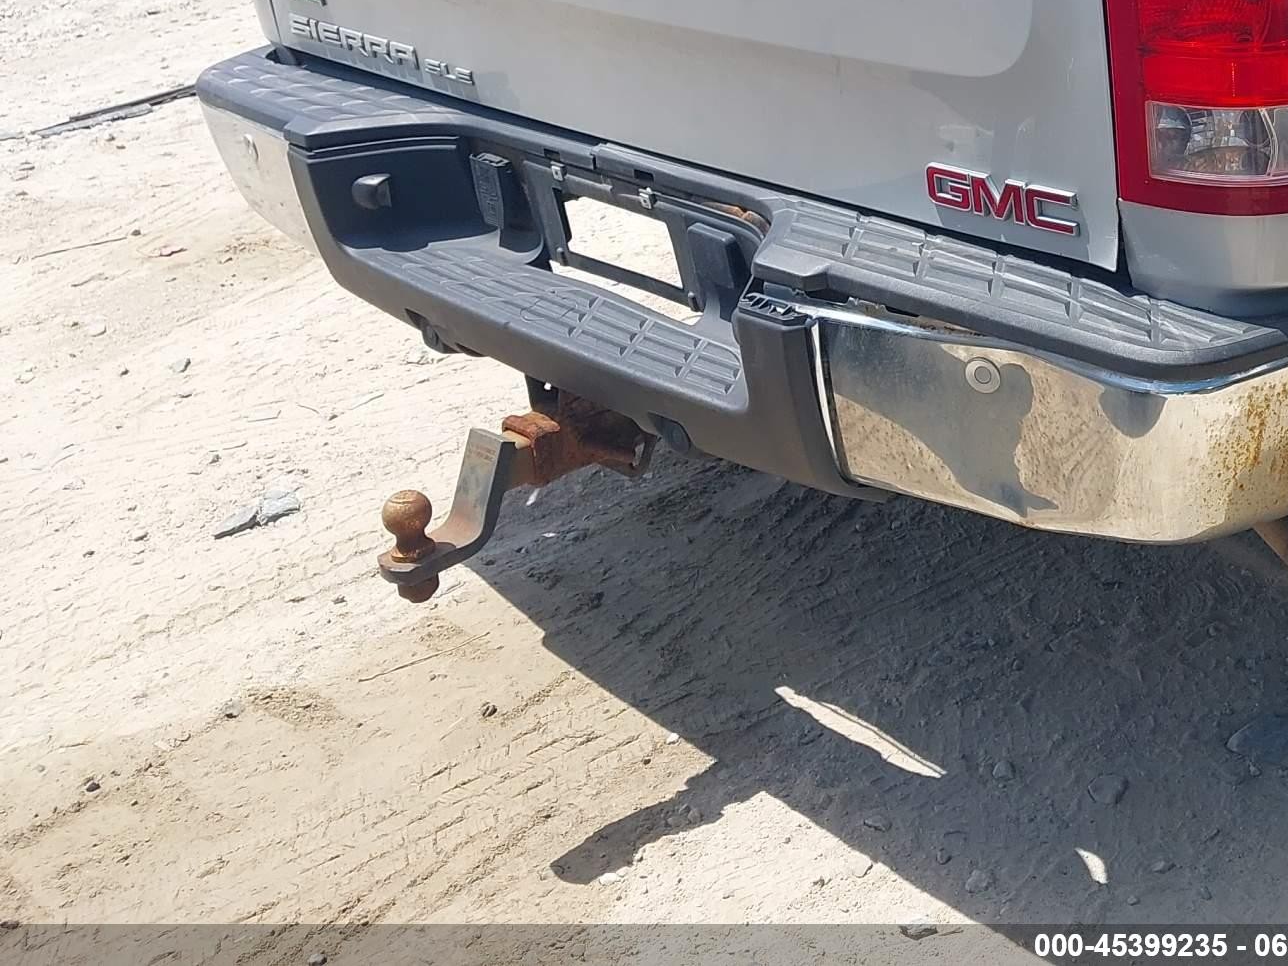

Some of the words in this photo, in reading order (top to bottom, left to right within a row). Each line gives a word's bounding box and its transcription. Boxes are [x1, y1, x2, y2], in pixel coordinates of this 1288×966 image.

[289, 12, 421, 71] SIERRA
[424, 58, 475, 85] SLE
[925, 161, 1081, 236] GMC
